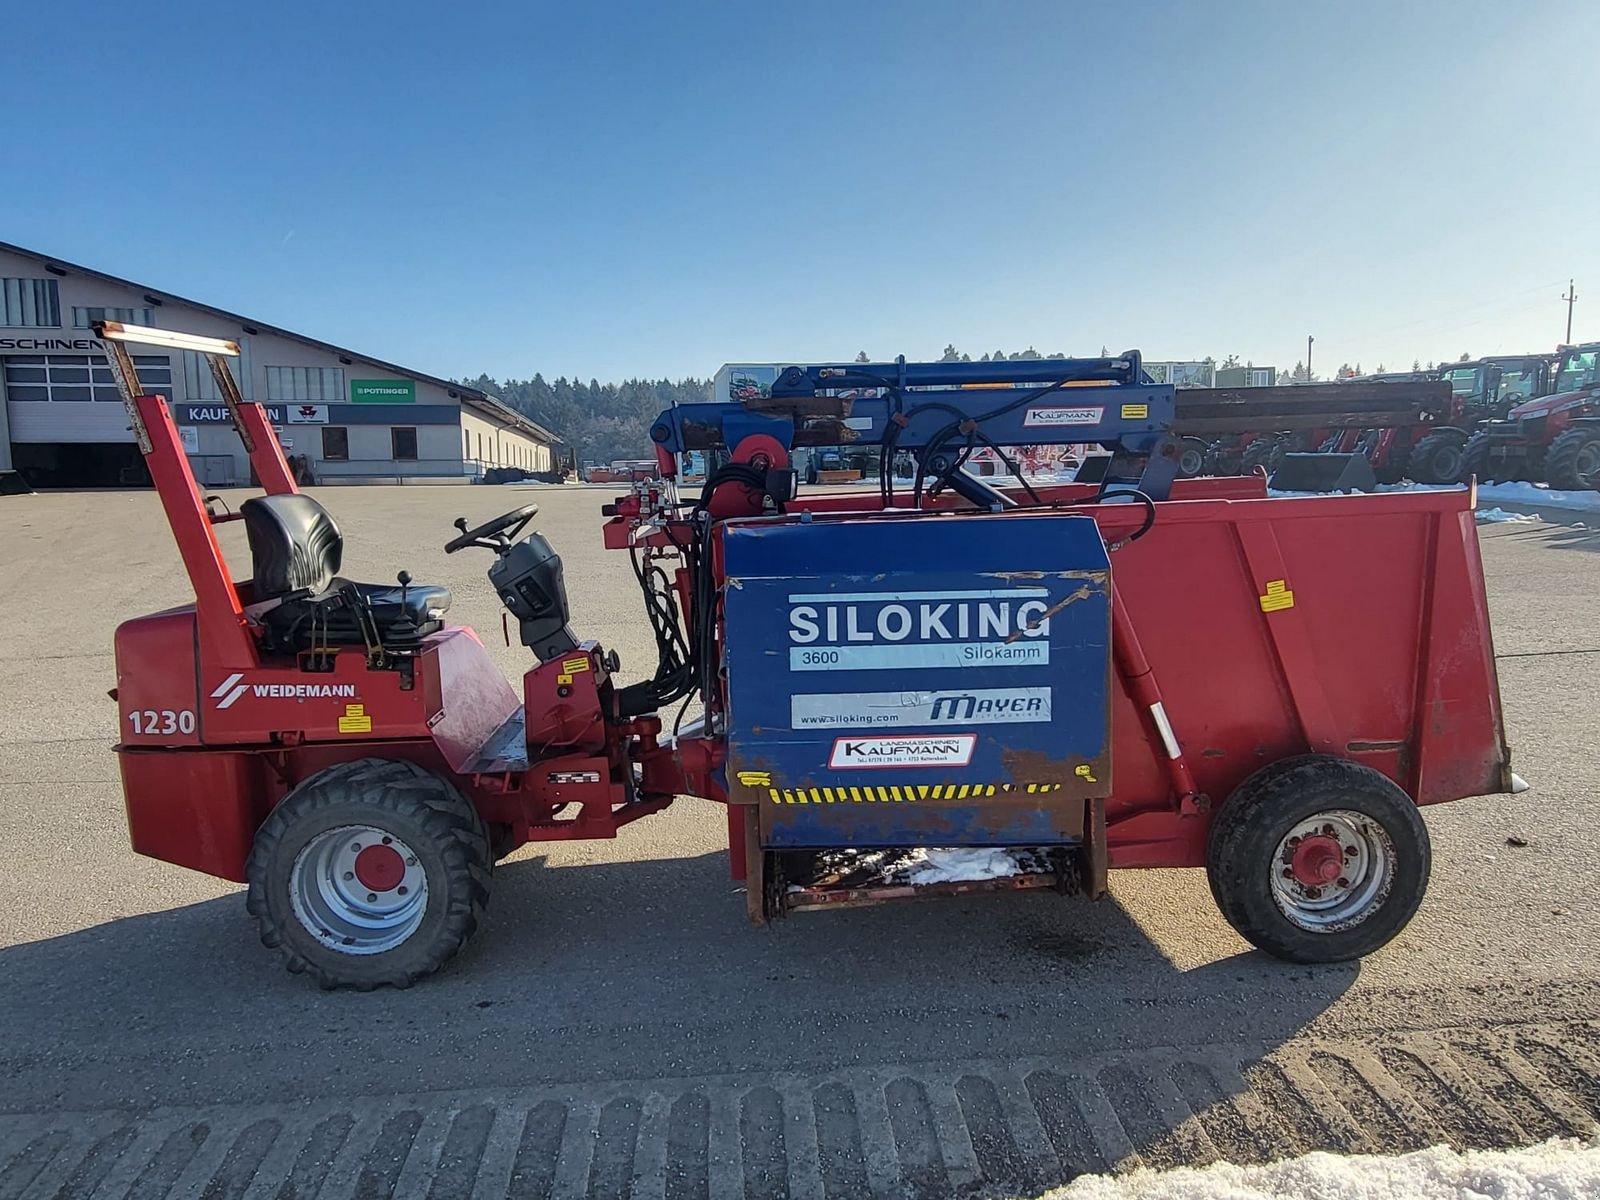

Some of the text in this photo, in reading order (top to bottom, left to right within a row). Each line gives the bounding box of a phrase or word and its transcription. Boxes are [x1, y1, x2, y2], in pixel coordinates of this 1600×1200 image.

[189, 408, 279, 420] KAUFN
[788, 600, 1050, 643] SILOKING
[802, 651, 839, 664] 3600
[964, 646, 1041, 660] Silokamm
[253, 684, 355, 697] WEIDEMANN
[930, 696, 1042, 720] MAYER
[128, 710, 195, 734] 1230
[800, 714, 899, 724] www.siloking.com
[845, 742, 960, 756] KAUFMANN
